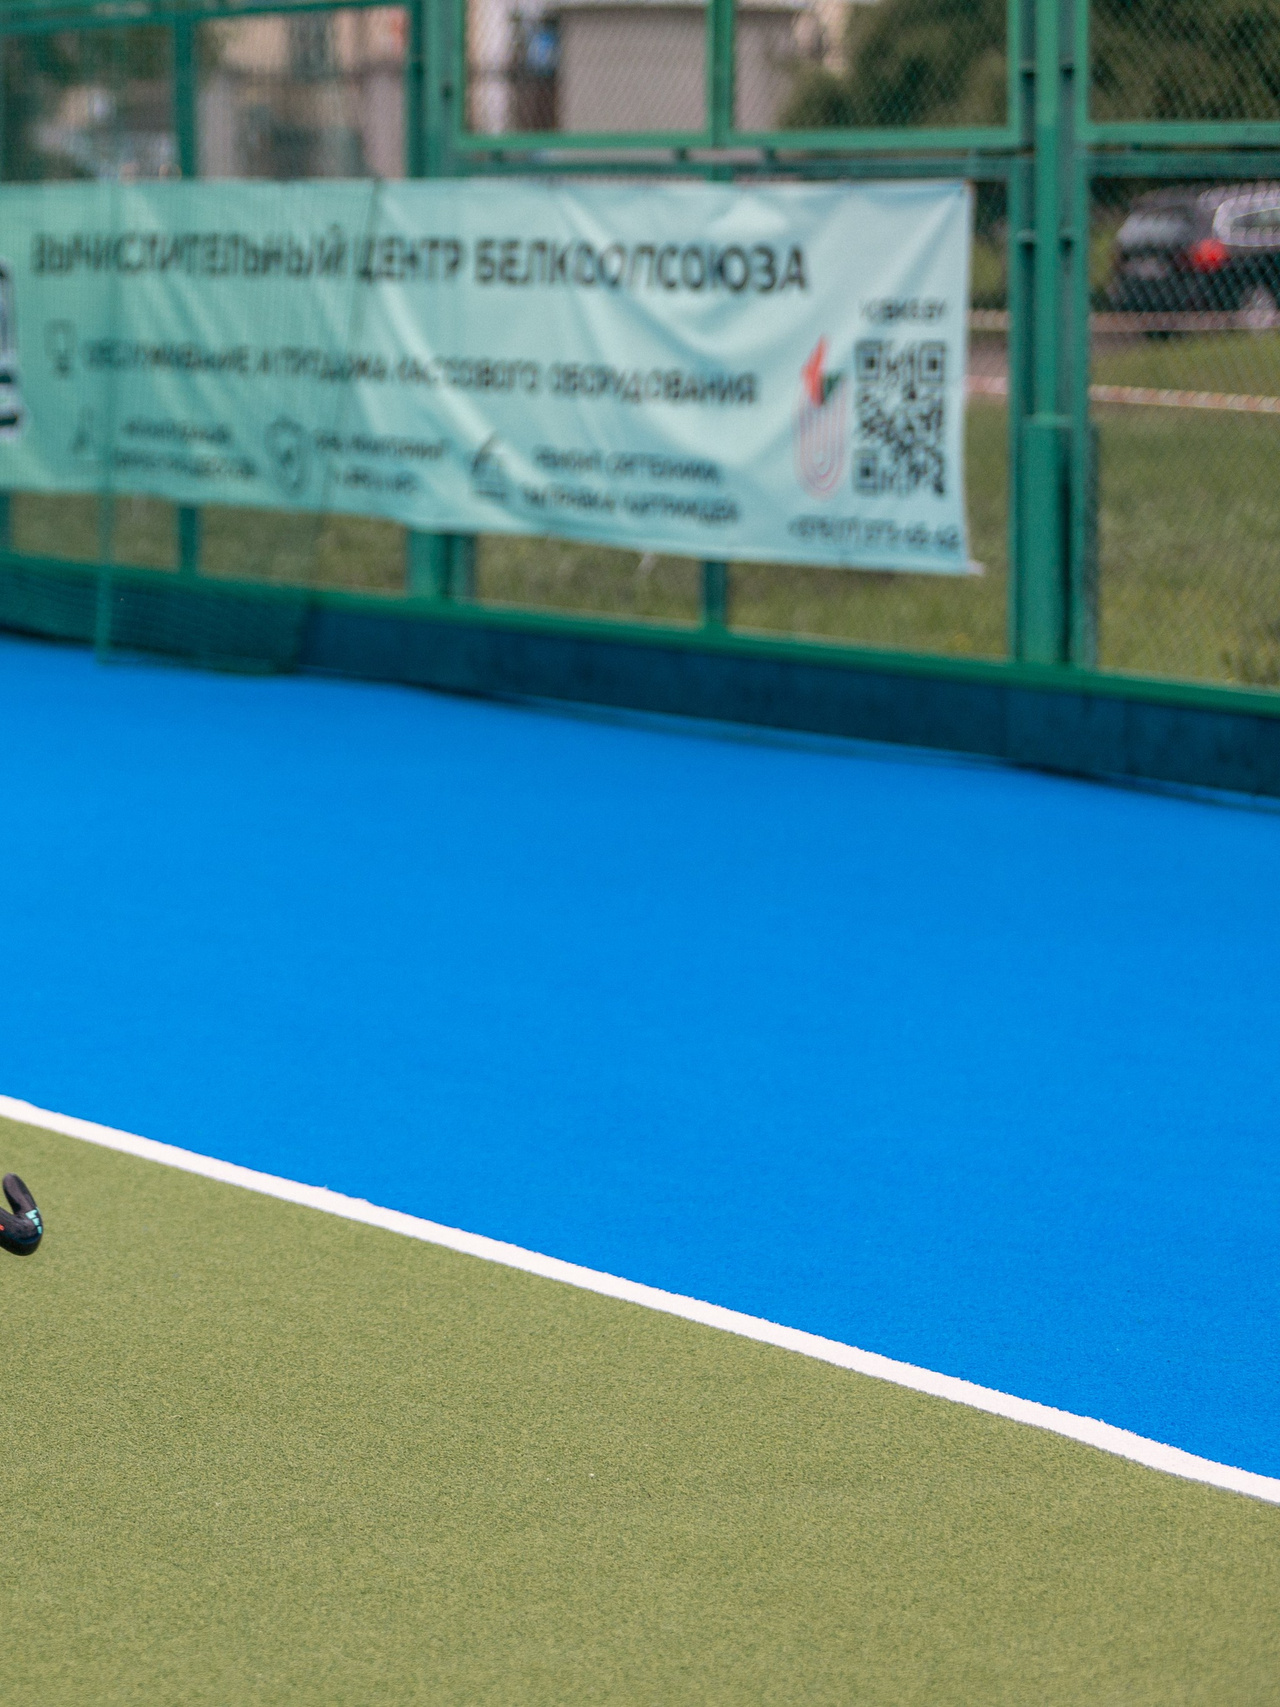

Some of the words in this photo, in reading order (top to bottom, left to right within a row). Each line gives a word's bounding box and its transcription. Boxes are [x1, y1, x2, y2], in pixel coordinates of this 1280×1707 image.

[357, 234, 460, 284] ЦЕНТР
[475, 237, 809, 294] БЕЛКООПСОЮЗА
[548, 360, 760, 406] ОБОРУДОВАНИЯ
